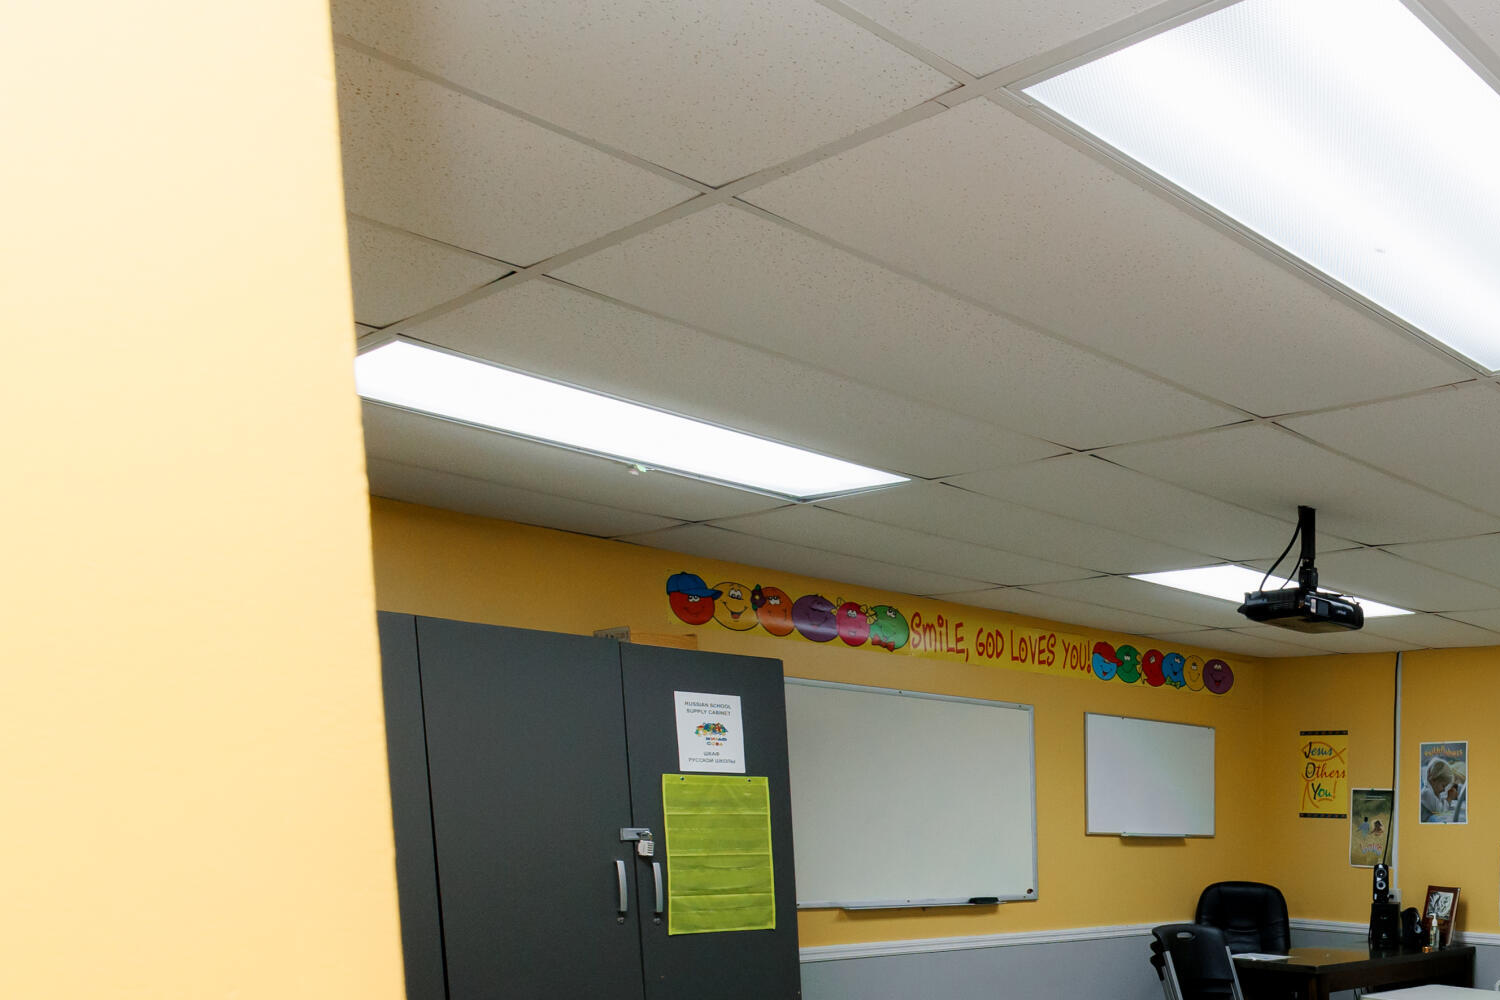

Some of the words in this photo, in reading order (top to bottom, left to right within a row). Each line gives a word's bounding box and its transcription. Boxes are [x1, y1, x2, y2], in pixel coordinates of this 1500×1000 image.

[975, 627, 1005, 660] GOD
[1010, 629, 1057, 667] LOVES
[1062, 639, 1092, 674] YOU!
[1303, 741, 1333, 759] Jesus
[1305, 761, 1347, 779] Others
